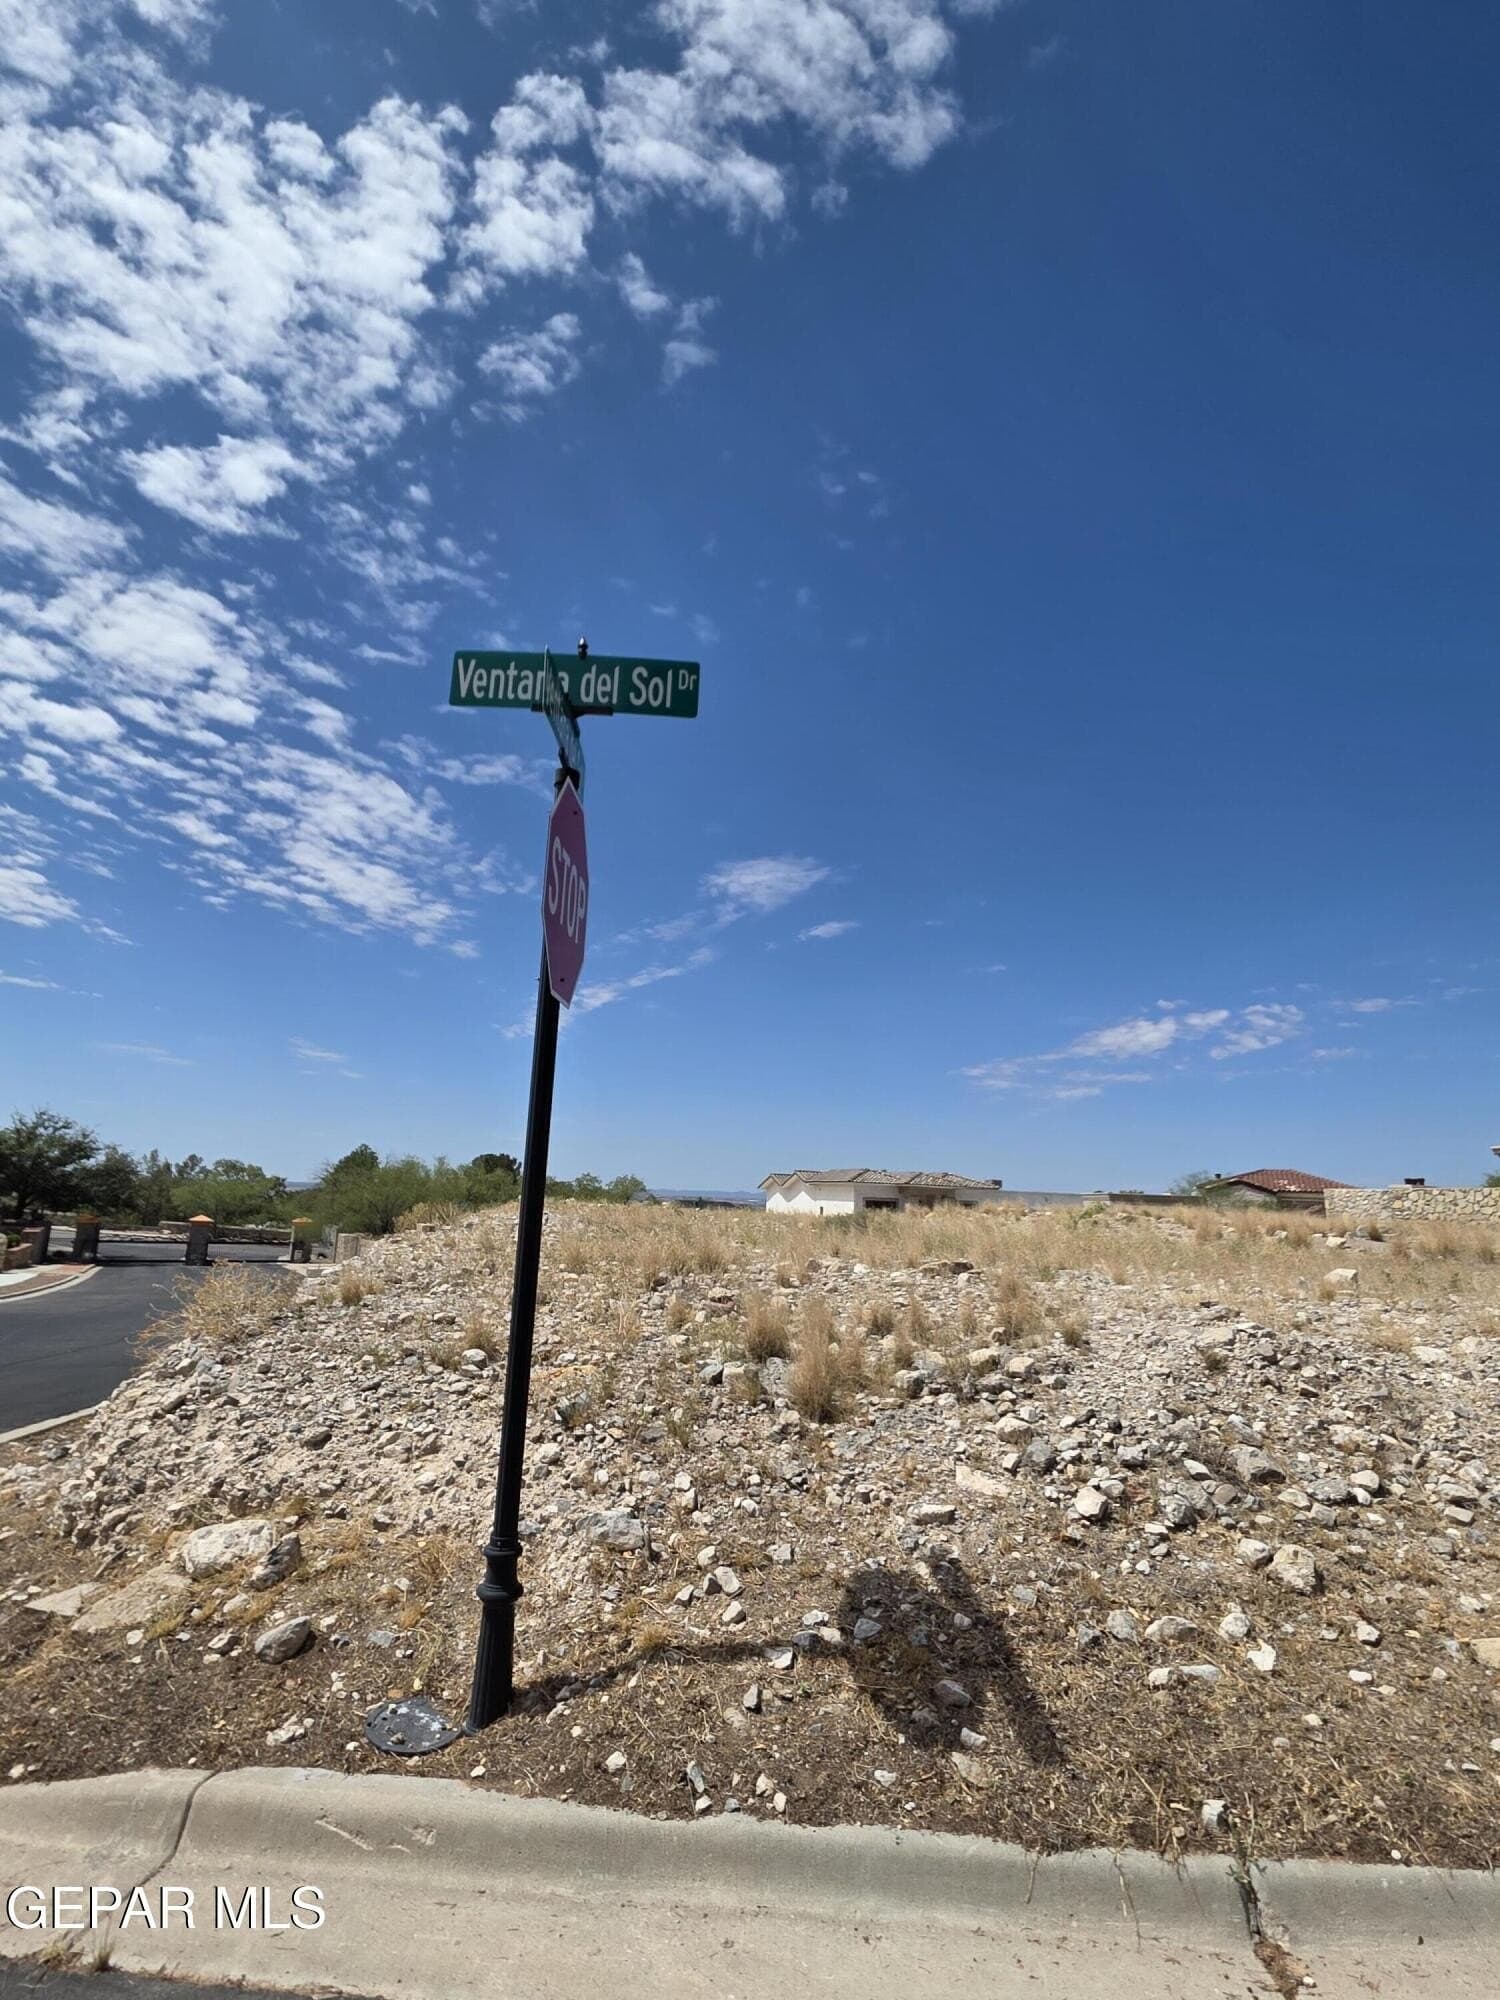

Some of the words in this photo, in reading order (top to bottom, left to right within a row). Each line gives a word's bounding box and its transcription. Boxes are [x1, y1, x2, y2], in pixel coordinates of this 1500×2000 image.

[580, 664, 619, 705] del
[629, 666, 673, 708] Sol
[678, 669, 697, 691] Dr
[549, 836, 585, 943] STOP
